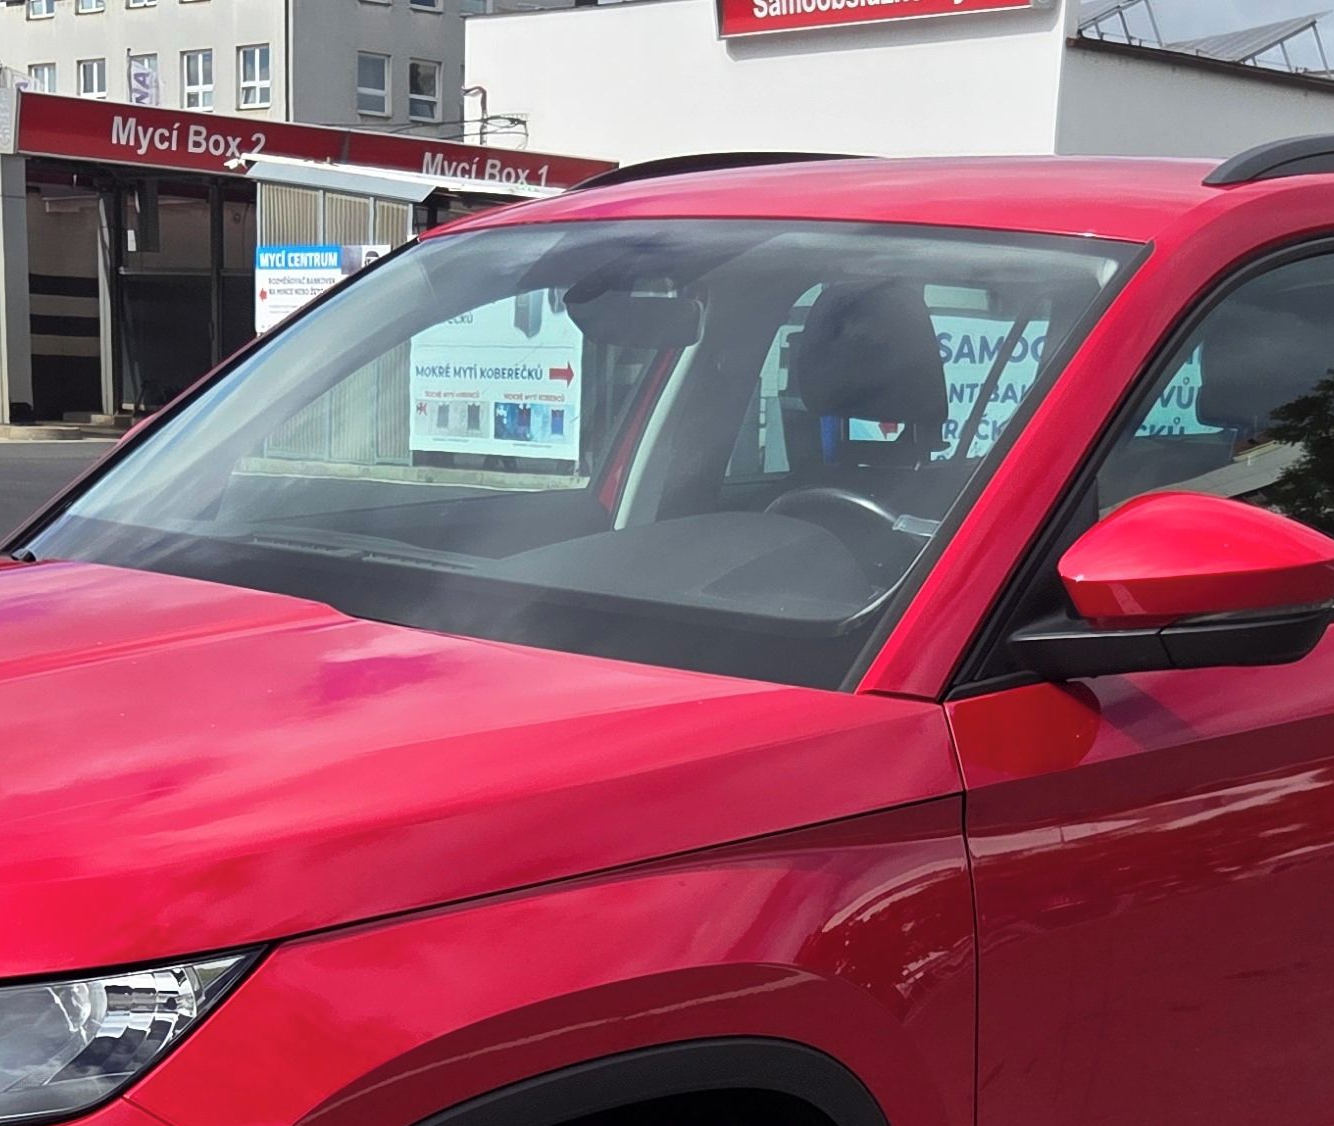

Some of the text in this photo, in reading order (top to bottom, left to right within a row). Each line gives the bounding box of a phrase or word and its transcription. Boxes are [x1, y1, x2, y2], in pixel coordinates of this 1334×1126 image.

[111, 116, 266, 157] Mycí Box 2
[485, 159, 530, 185] Box
[537, 165, 549, 187] 1
[259, 250, 338, 267] MYCÍ CENTRUM
[416, 364, 543, 381] MOKRÉ MYTÍ KOBEREČKŮ
